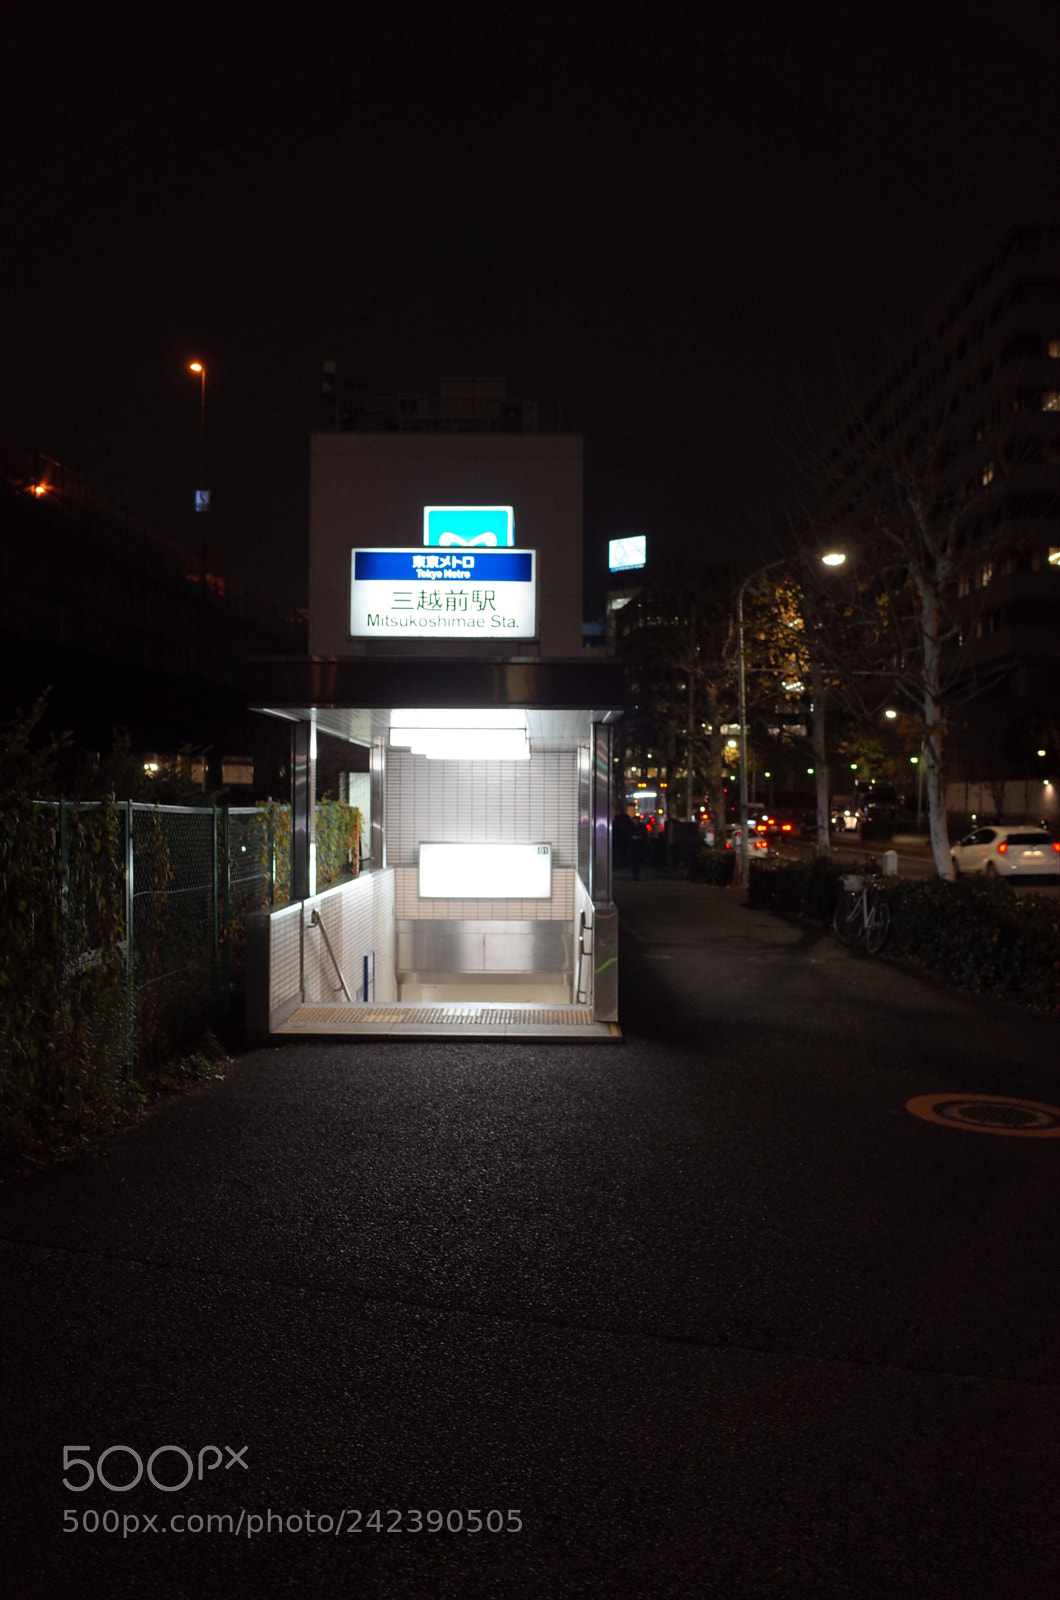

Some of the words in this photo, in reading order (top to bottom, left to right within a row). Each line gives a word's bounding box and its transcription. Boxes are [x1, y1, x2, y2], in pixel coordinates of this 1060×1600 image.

[412, 555, 475, 569] 東京メトロ
[416, 569, 443, 580] Tokyo
[443, 569, 471, 579] Metro
[390, 588, 497, 612] 三越前駅
[366, 613, 486, 628] Mitsukoshimae
[490, 614, 520, 628] Sta.
